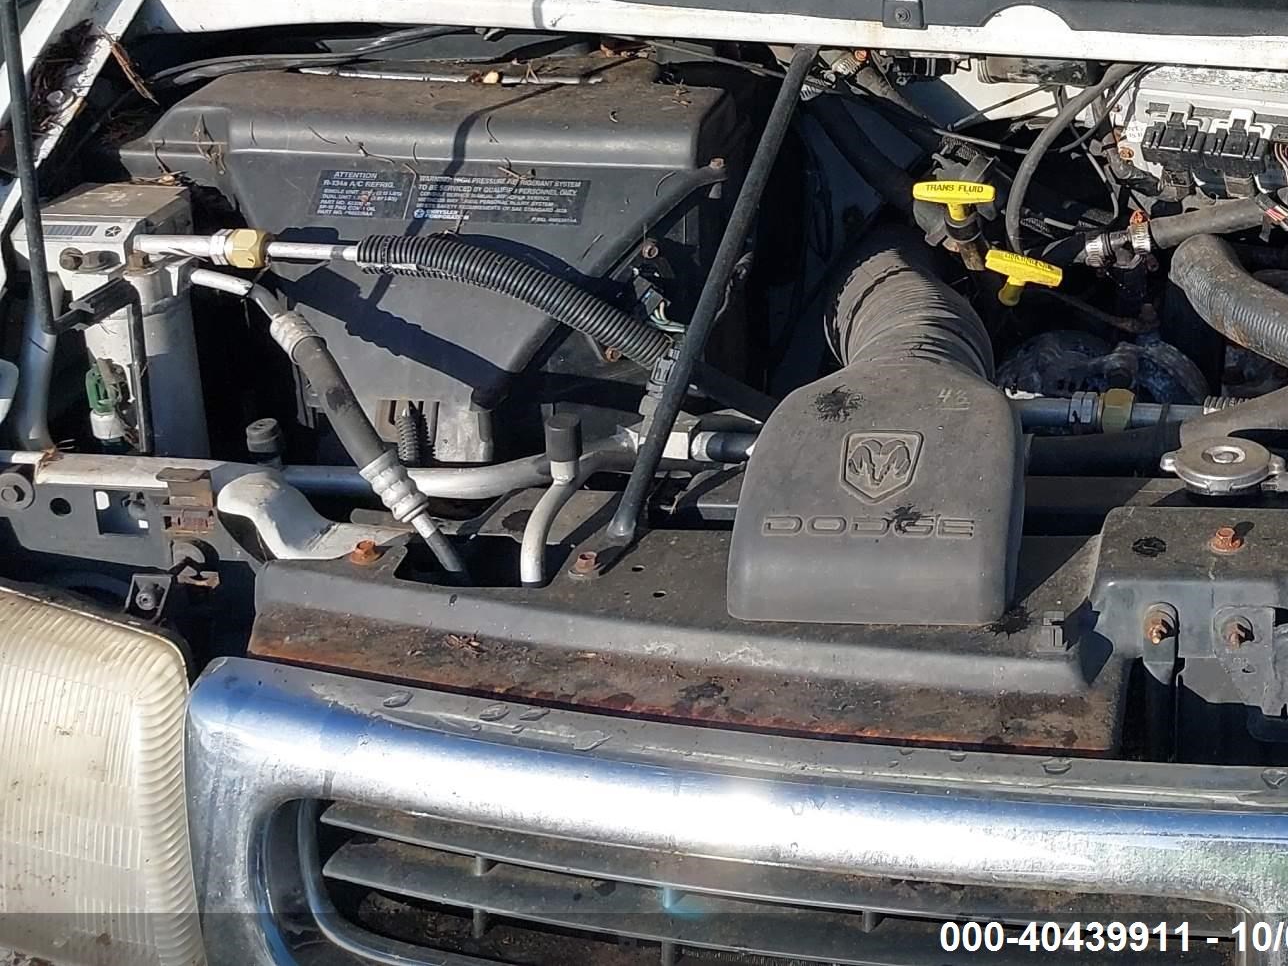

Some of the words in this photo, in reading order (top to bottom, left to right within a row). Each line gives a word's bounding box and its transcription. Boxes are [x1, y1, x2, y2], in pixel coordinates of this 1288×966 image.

[333, 171, 378, 180] ATTENTION
[472, 177, 506, 185] PRESSURE
[519, 188, 559, 196] PERSONNEL
[925, 184, 955, 192] TRANS
[957, 184, 985, 194] FLUID
[763, 514, 975, 539] DODGE
